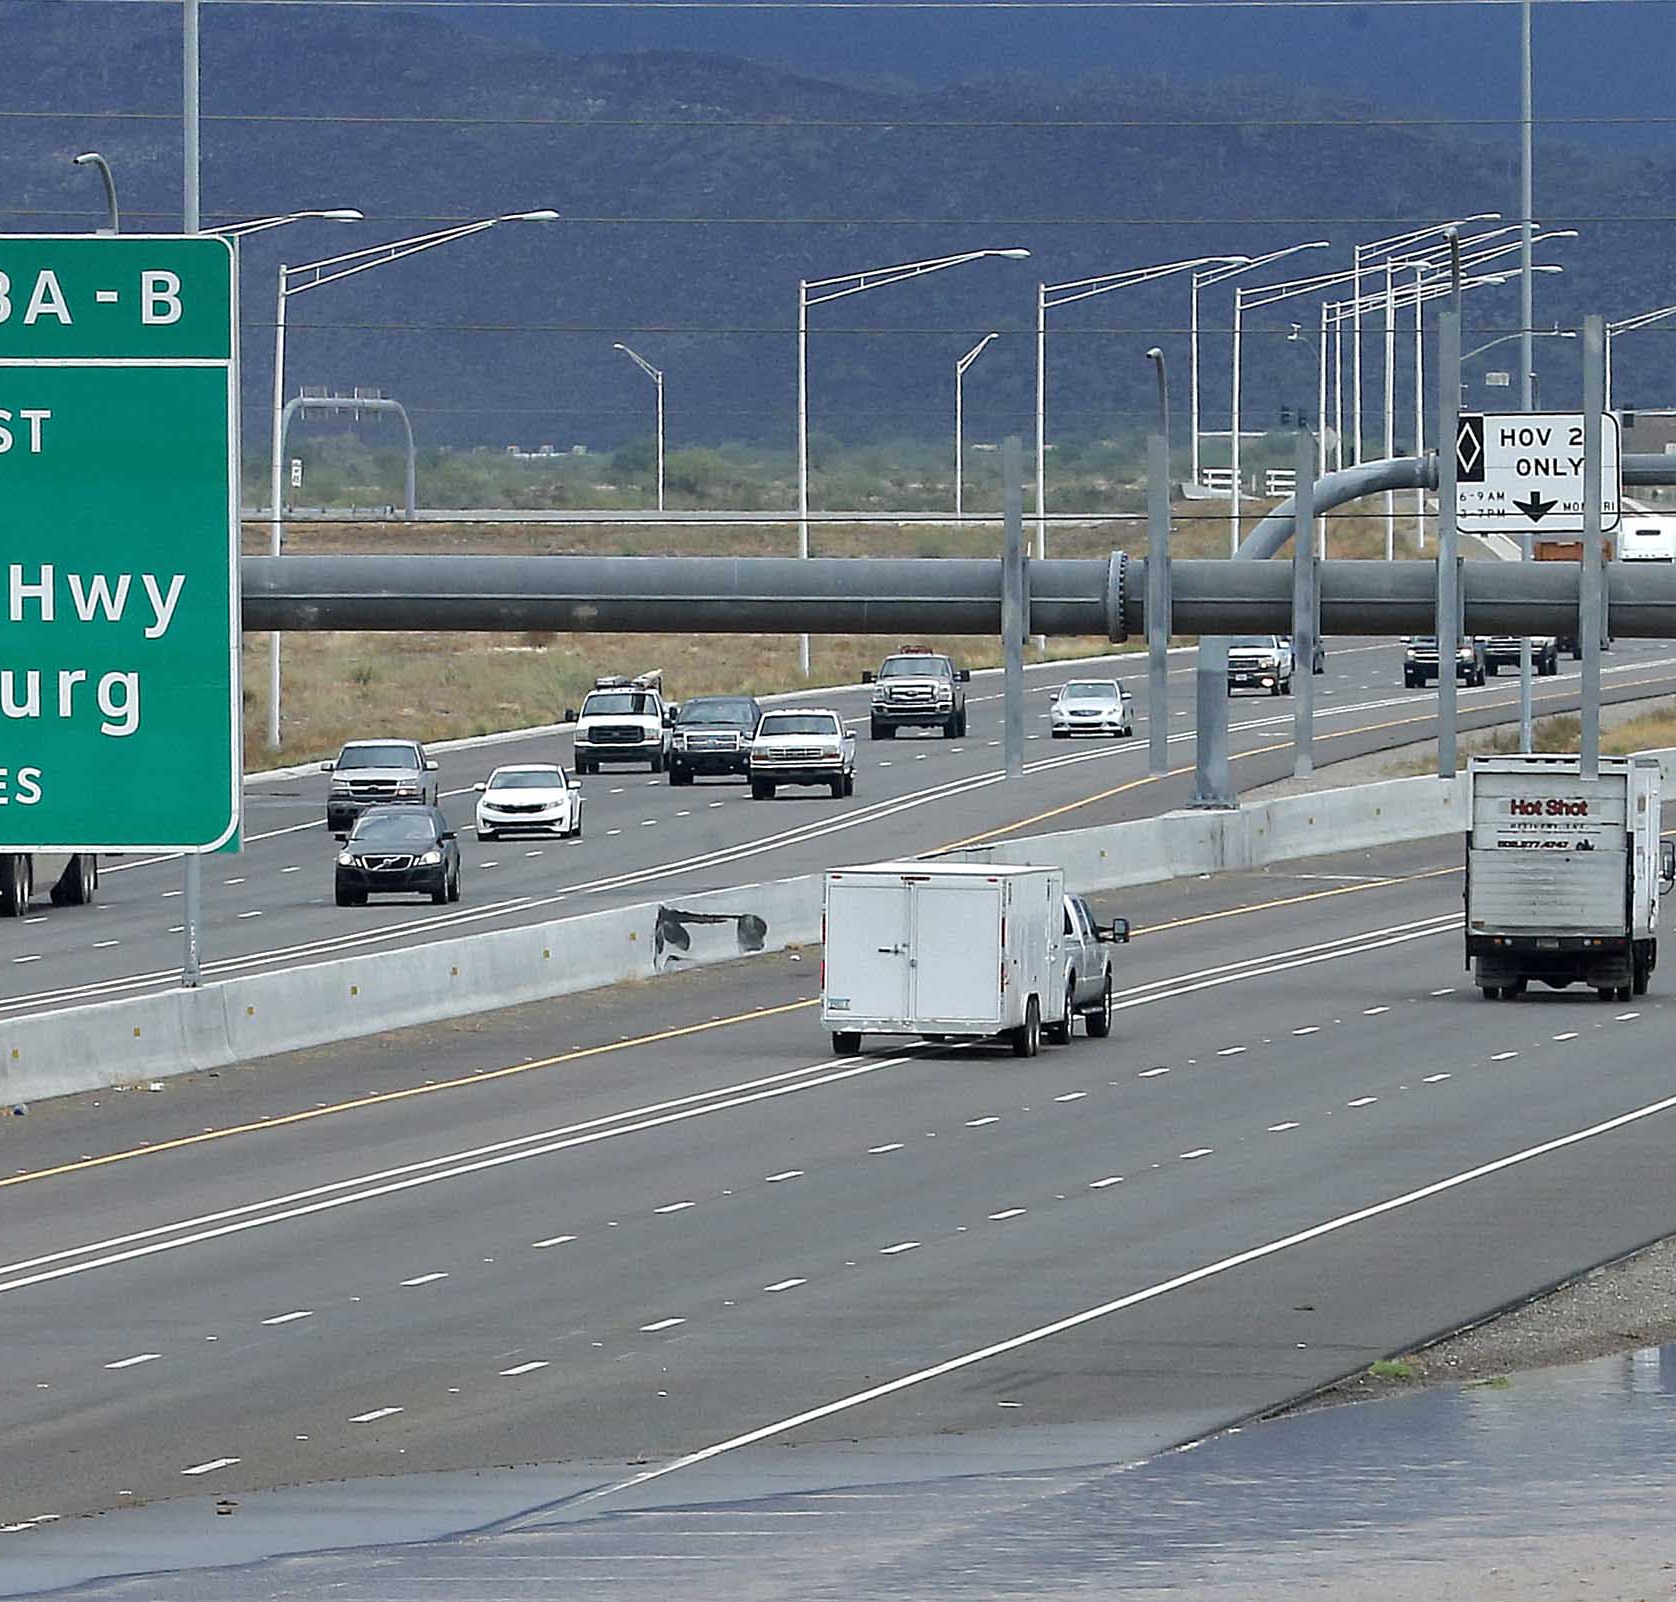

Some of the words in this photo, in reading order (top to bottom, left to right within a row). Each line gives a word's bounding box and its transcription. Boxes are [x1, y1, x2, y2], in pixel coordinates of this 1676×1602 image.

[1500, 428, 1551, 447] HOV
[1516, 457, 1585, 476] ONLY
[9, 563, 187, 638] Hwy
[1510, 799, 1542, 816] Hot
[1545, 799, 1588, 816] Shot
